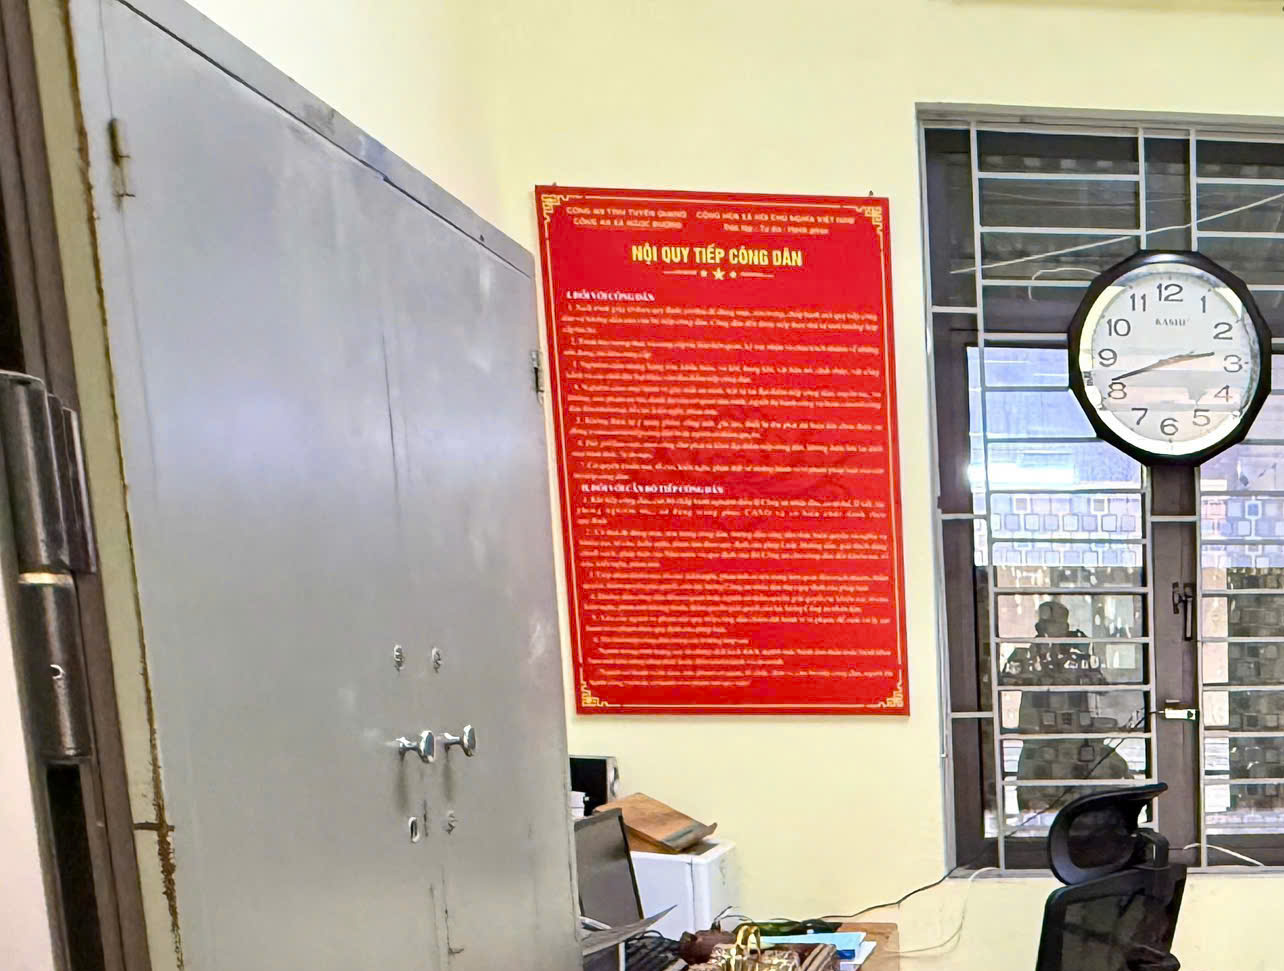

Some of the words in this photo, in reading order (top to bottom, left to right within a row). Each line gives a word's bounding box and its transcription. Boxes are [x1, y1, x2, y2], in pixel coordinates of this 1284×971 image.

[631, 242, 658, 265] NỘI
[661, 246, 690, 264] QUY
[693, 243, 725, 264] TIẾP
[728, 245, 769, 266] CÔNG
[772, 247, 803, 267] DÂN
[1156, 282, 1184, 302] 12
[1130, 293, 1147, 312] 11
[1200, 295, 1206, 313] 1
[1106, 318, 1131, 337] 10
[1213, 322, 1233, 340] 2
[1097, 348, 1118, 367] 9
[1223, 354, 1243, 373] 3
[1107, 381, 1127, 400] 8
[1214, 384, 1233, 402] 4
[1131, 407, 1148, 426] 7
[1192, 408, 1211, 427] 5
[1160, 417, 1179, 436] 6
